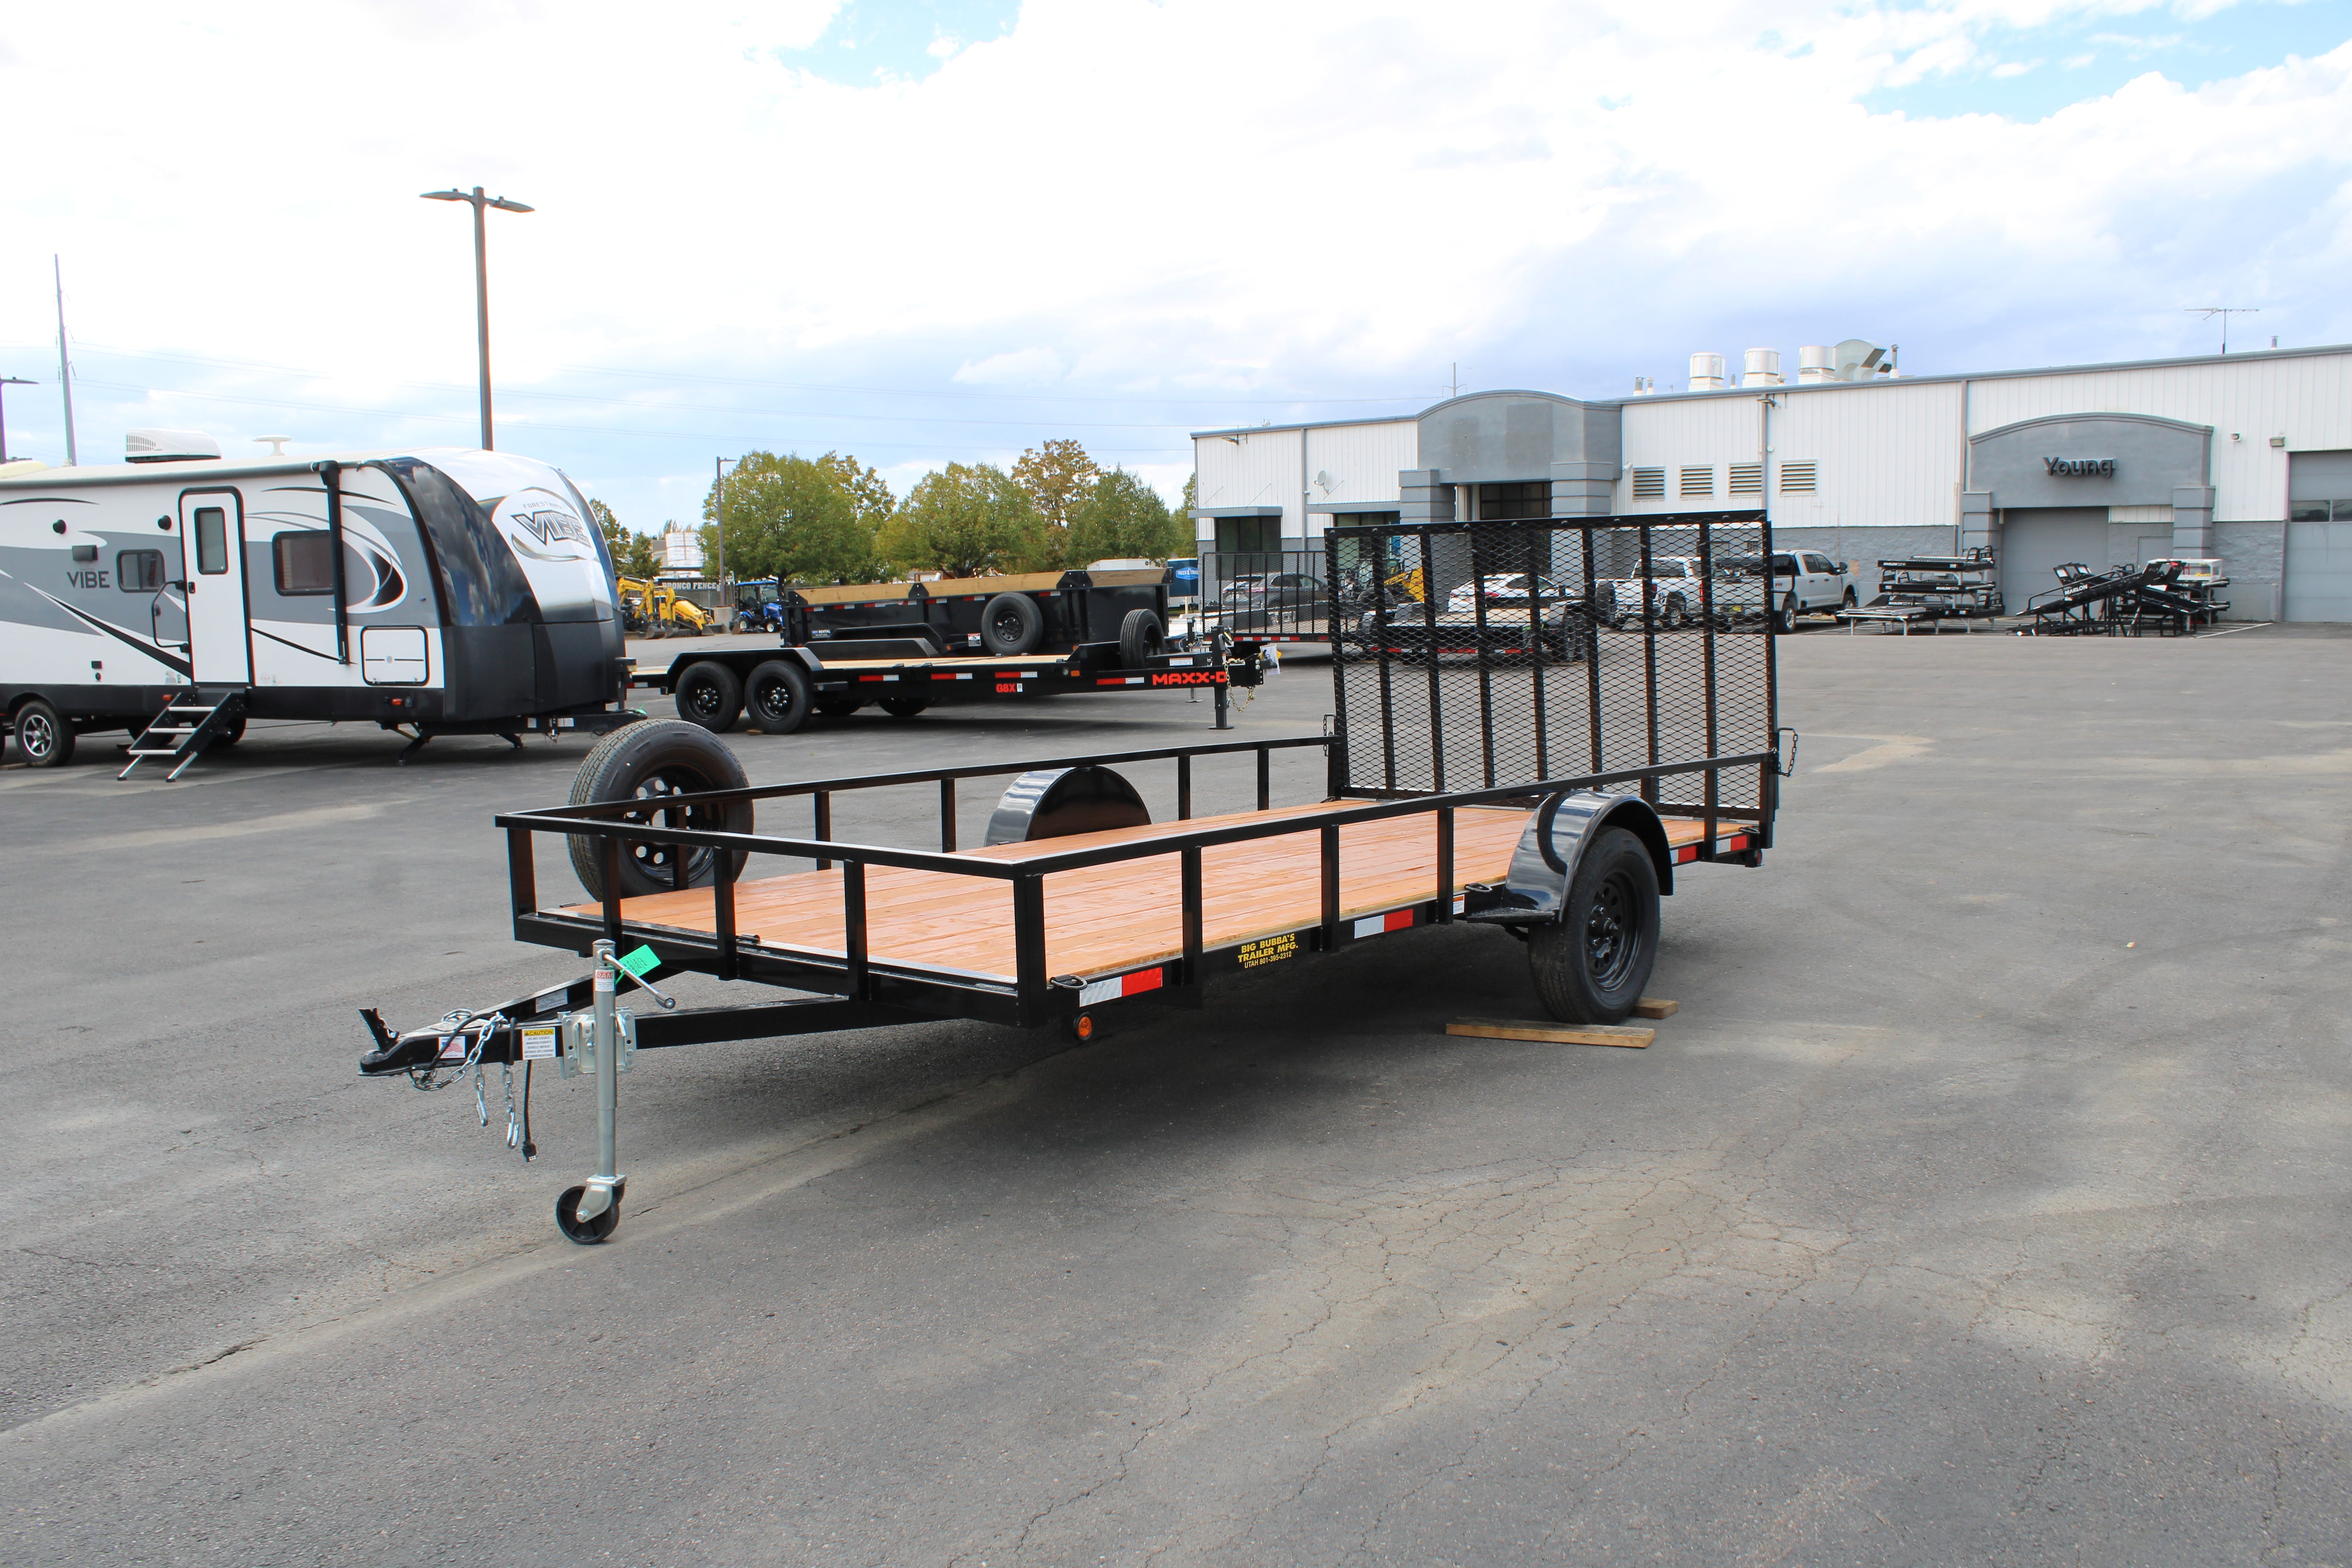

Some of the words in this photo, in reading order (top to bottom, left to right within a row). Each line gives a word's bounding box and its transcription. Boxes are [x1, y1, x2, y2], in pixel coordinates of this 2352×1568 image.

[2042, 457, 2113, 479] Young
[523, 501, 548, 509] FOREST
[510, 510, 592, 547] VIBE
[67, 571, 110, 588] VIBE
[2065, 584, 2088, 596] MARLON
[1152, 671, 1227, 686] MAXX-D
[996, 683, 1016, 693] G8X
[1241, 943, 1256, 953] BIG
[1260, 933, 1295, 949] BUBBA'S
[1238, 947, 1274, 963] TRAILER
[1277, 942, 1298, 953] MFG.
[1245, 959, 1258, 968] UTAH
[1260, 951, 1292, 964] 801-395-2312
